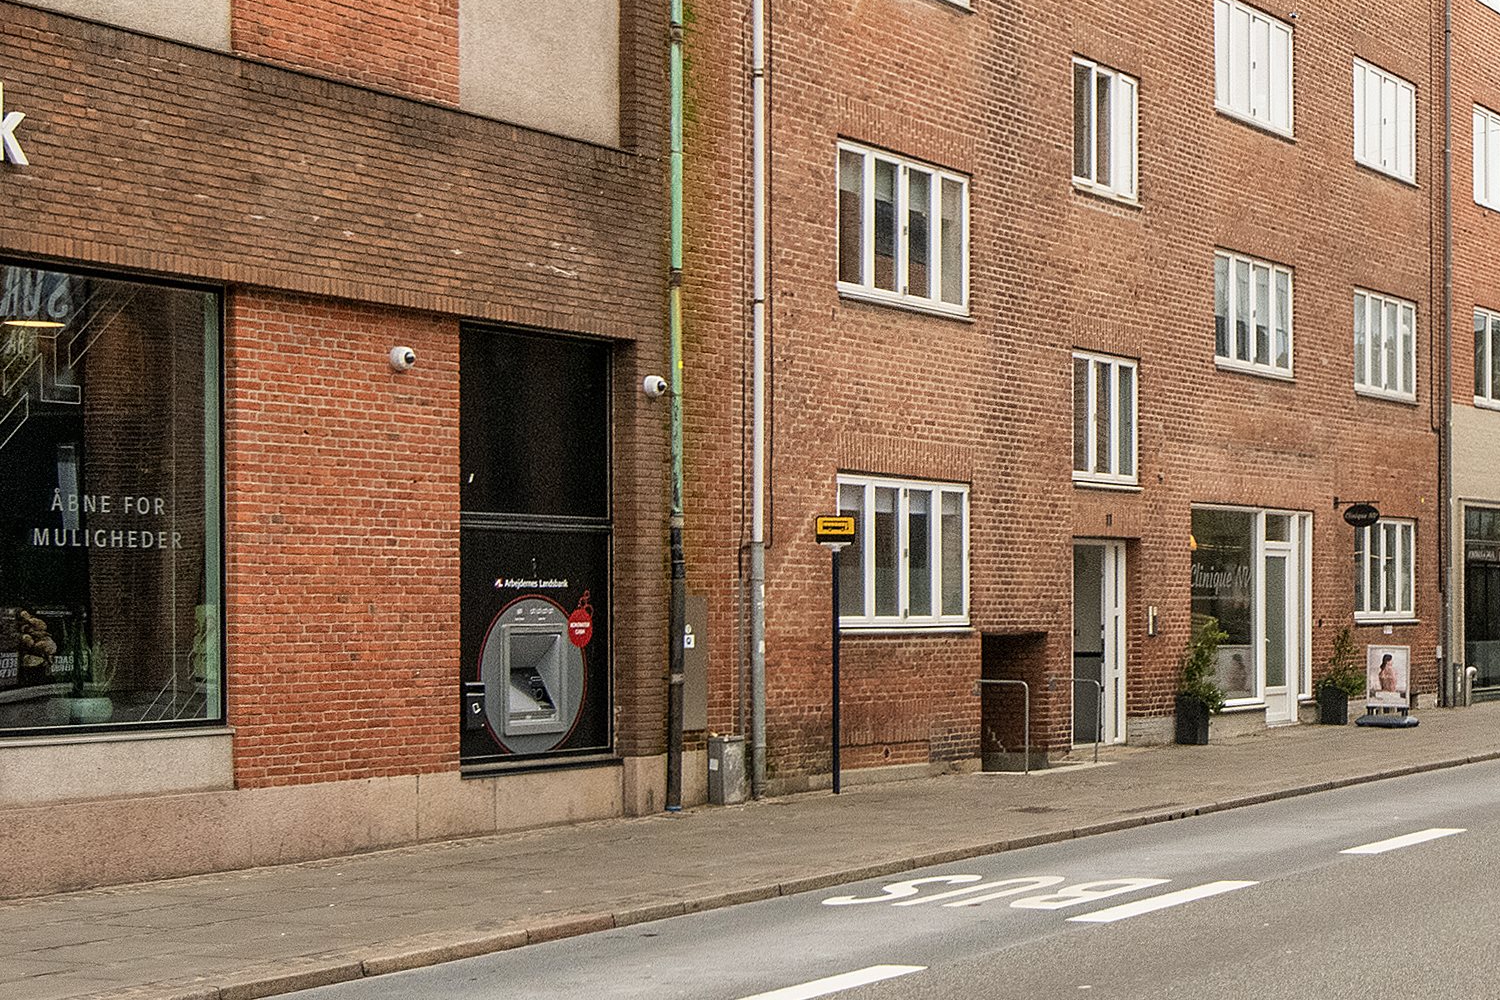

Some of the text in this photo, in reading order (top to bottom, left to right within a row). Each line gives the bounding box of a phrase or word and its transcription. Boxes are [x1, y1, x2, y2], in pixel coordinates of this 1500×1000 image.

[51, 487, 165, 515] ÅBNE FOR
[33, 527, 183, 549] MULIGHEDER
[504, 579, 568, 590] Arbejdernes Landsbank
[1191, 563, 1232, 595] Clinique
[821, 874, 1173, 910] BUS
